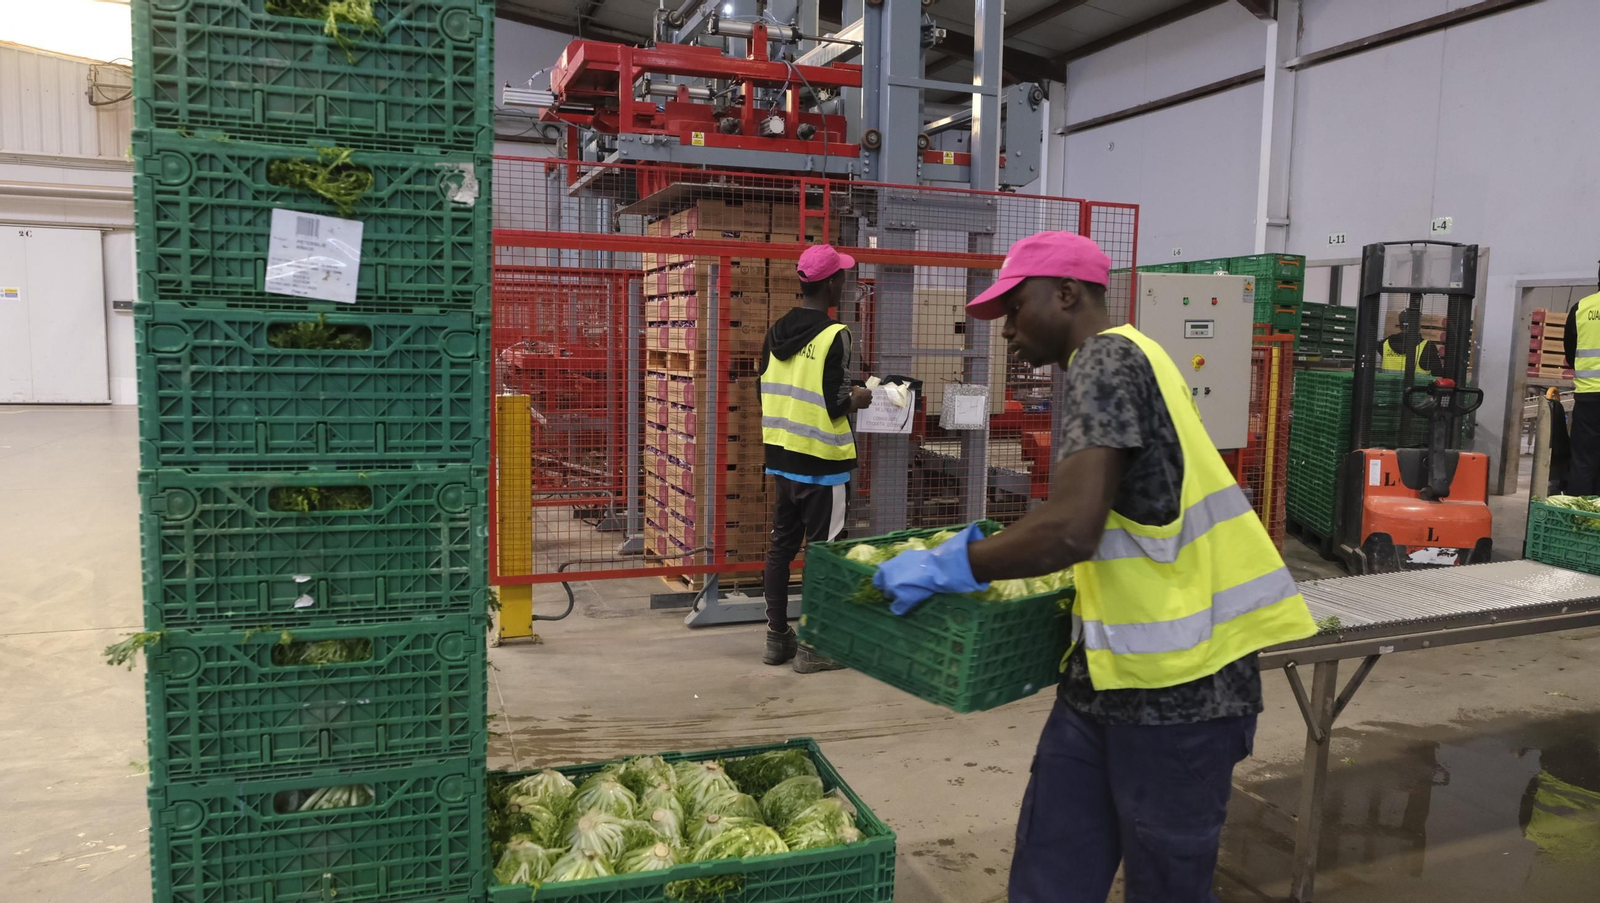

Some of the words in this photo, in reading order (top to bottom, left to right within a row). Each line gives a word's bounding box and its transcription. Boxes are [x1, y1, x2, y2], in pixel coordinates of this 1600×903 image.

[1432, 220, 1447, 231] L-4
[1328, 234, 1346, 244] L-11
[1427, 527, 1439, 541] L
